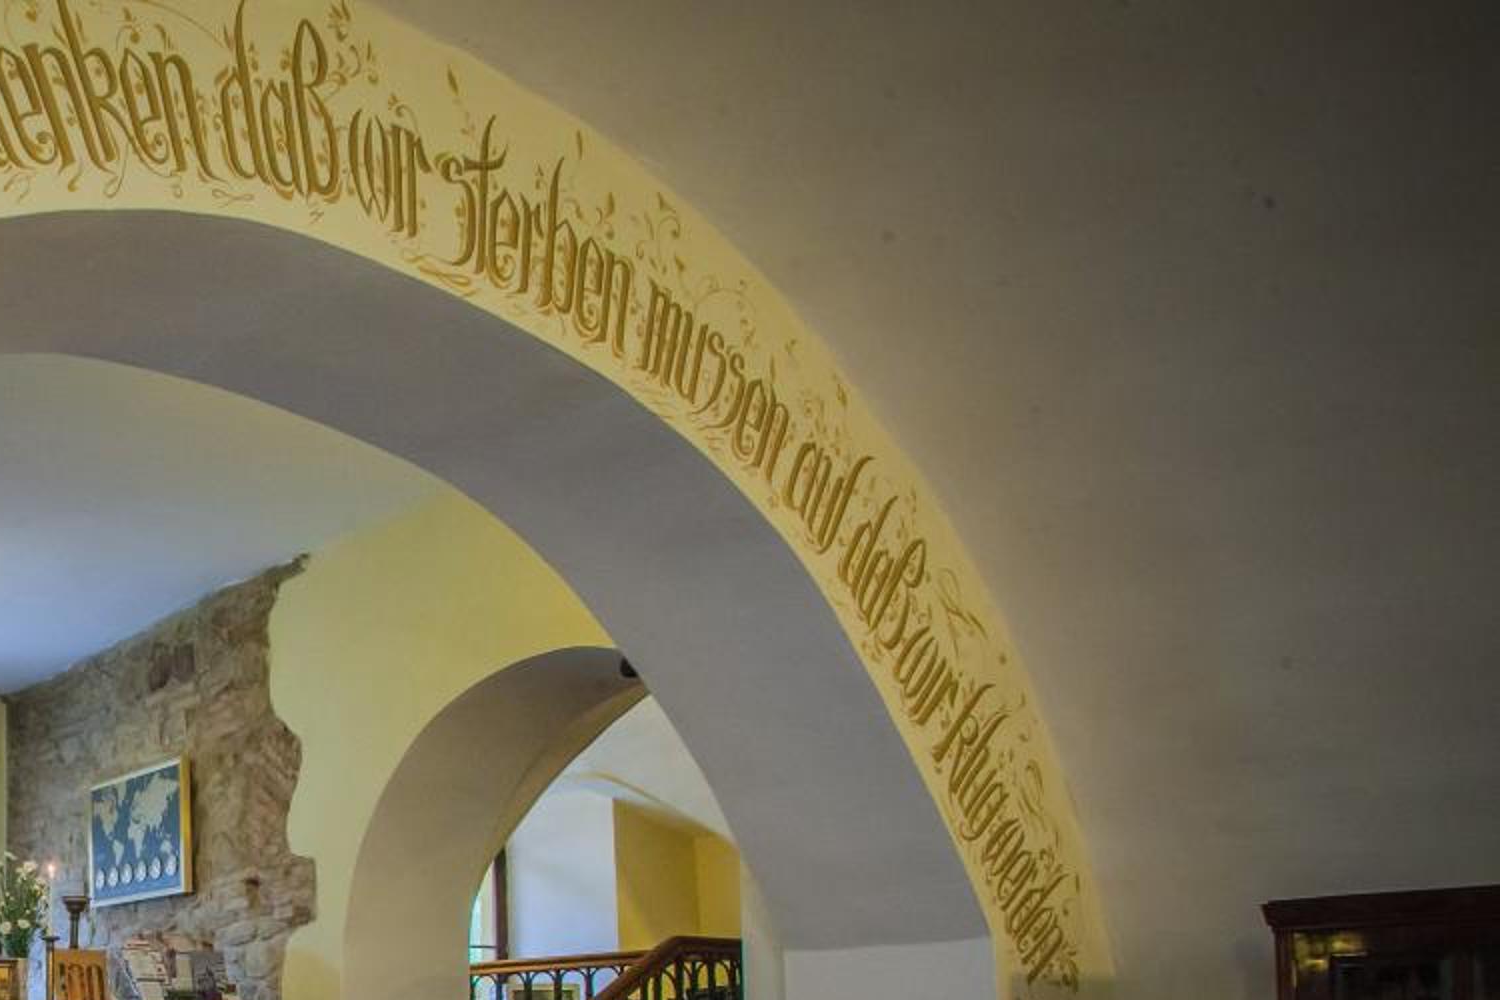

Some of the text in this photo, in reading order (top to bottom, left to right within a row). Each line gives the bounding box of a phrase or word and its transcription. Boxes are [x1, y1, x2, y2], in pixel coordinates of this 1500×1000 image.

[218, 0, 342, 202] daß
[347, 108, 431, 238] wir
[785, 442, 875, 555] auf
[838, 495, 927, 650] daß
[894, 626, 958, 726] wir
[932, 682, 1010, 842] klug
[980, 815, 1070, 986] werden
